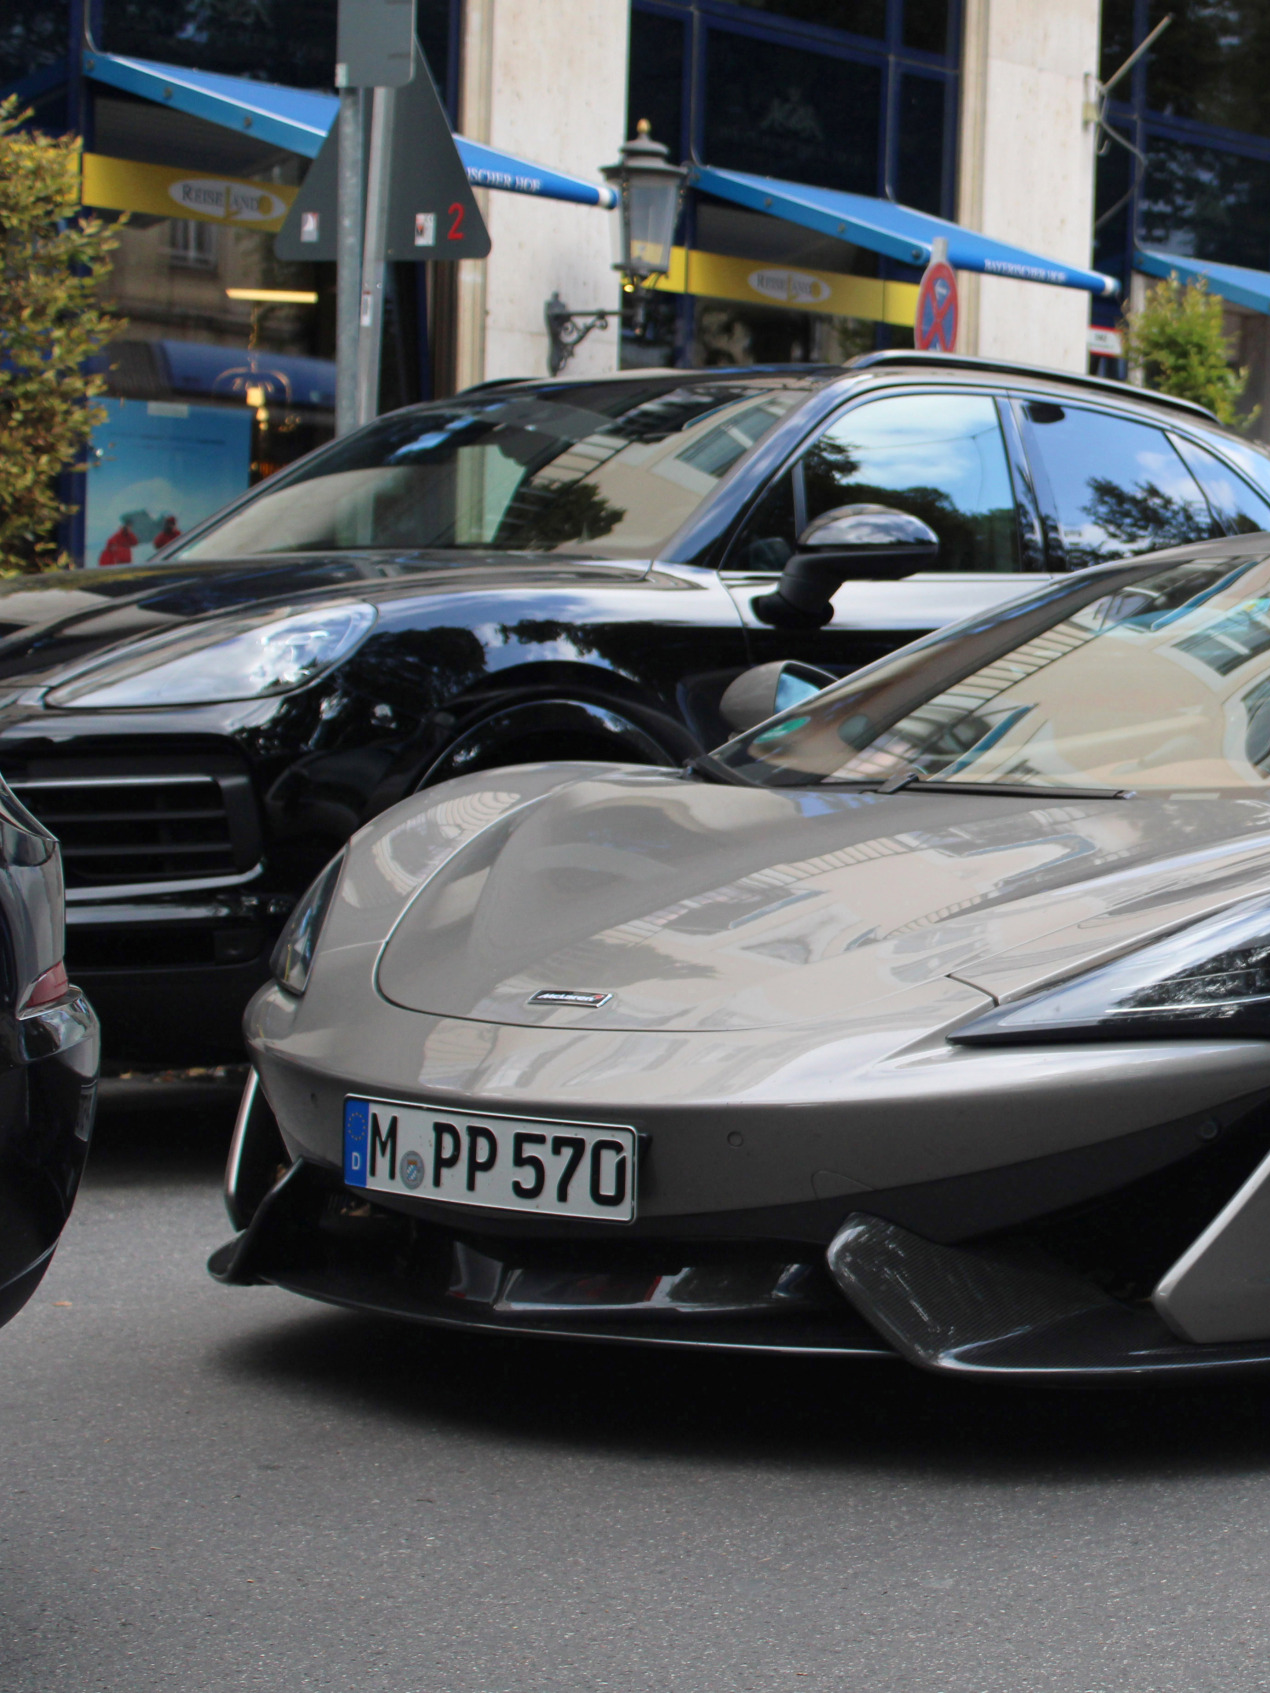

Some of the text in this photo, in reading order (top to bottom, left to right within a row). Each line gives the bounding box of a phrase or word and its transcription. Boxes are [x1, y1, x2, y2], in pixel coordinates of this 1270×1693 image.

[448, 202, 464, 240] 2
[536, 993, 596, 1002] McLaren
[351, 1151, 361, 1171] D
[369, 1112, 627, 1207] M PP 570
